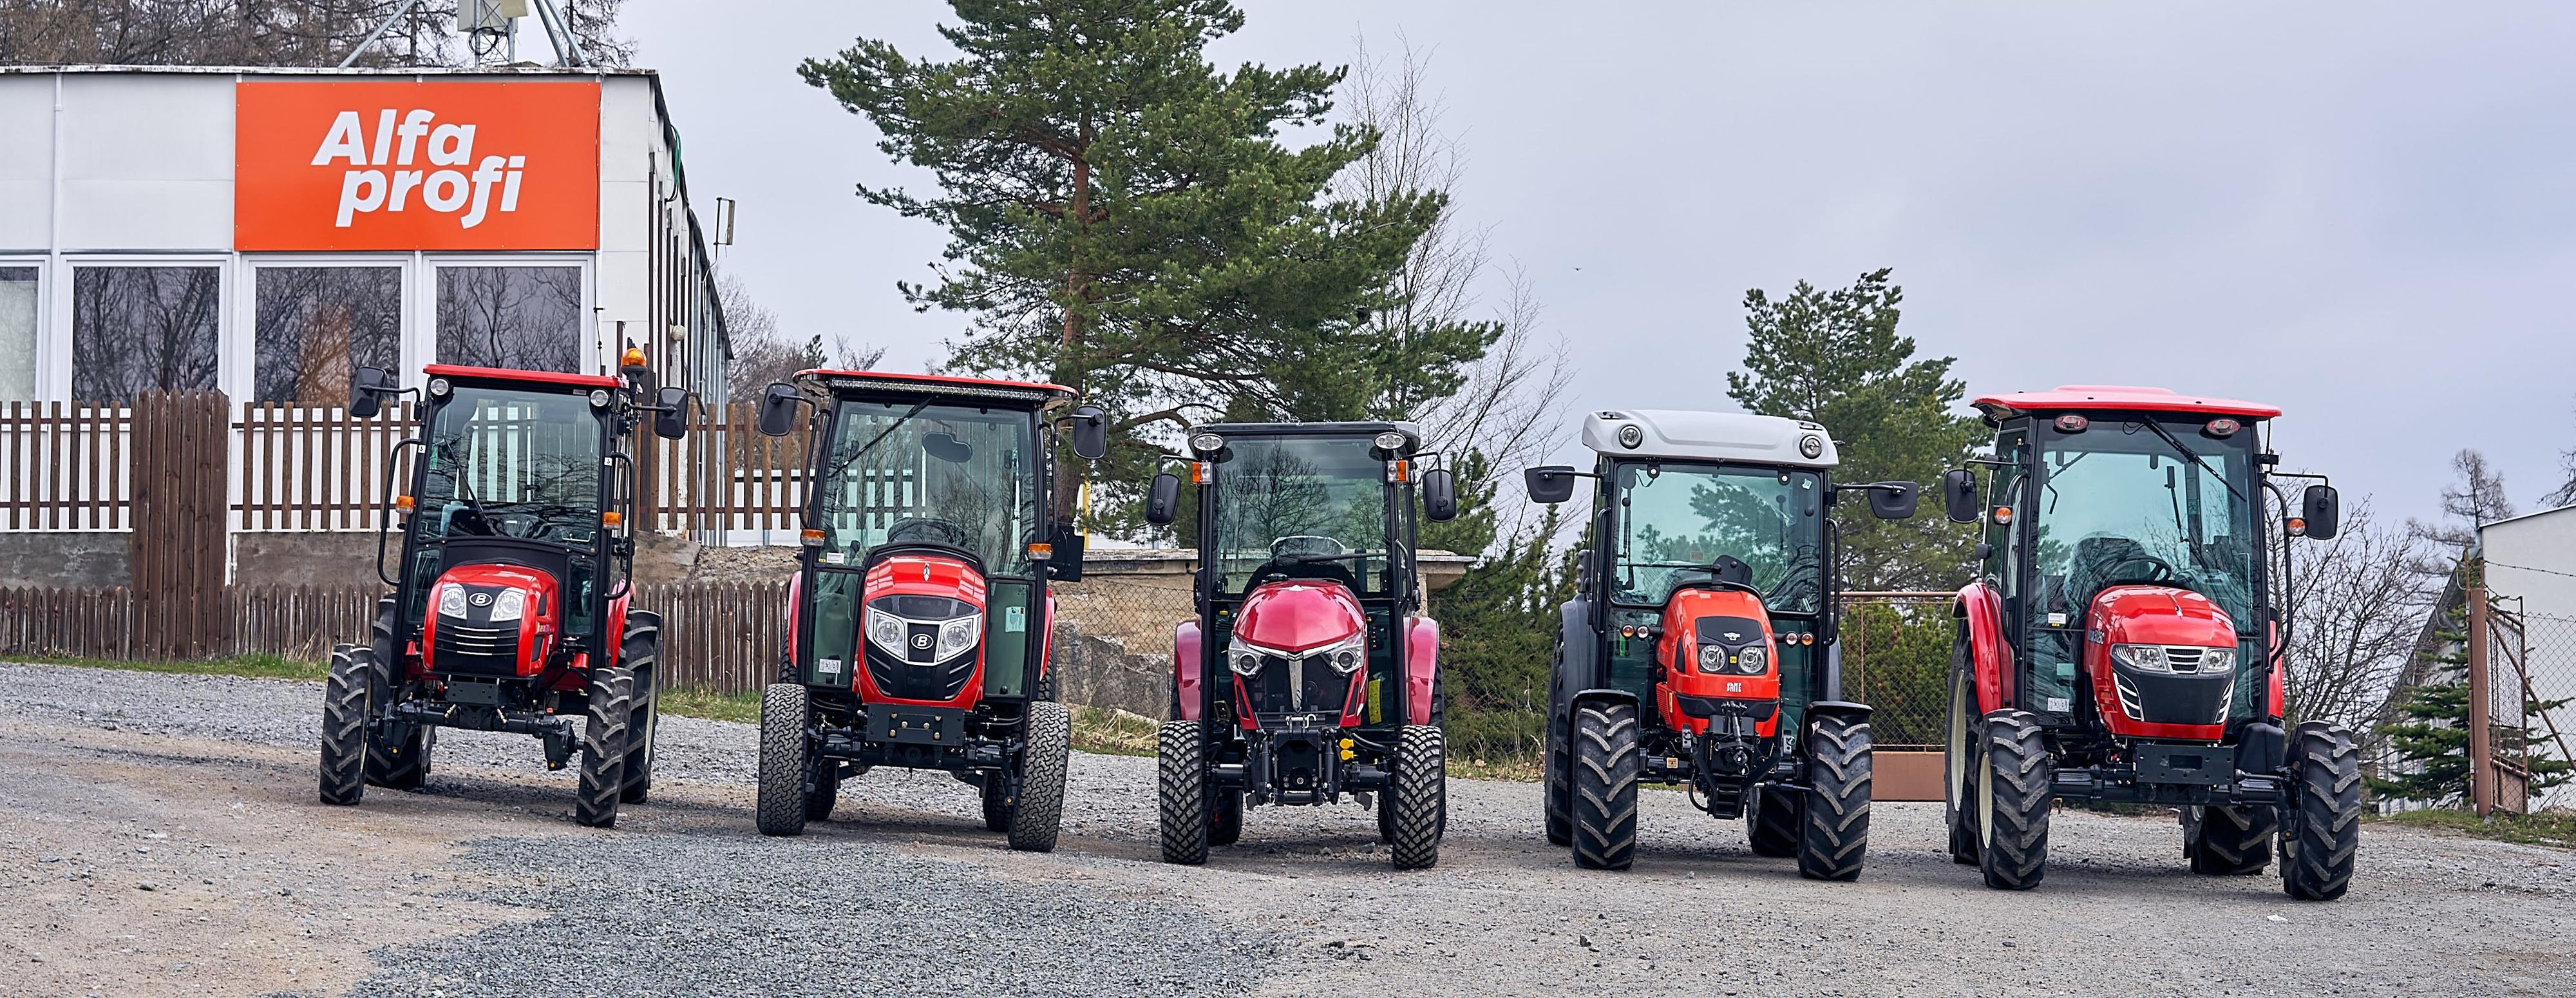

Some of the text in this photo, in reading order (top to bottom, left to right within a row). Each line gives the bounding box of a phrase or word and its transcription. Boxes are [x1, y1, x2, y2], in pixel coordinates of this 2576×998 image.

[310, 108, 477, 166] Alfa
[335, 155, 526, 229] profi
[475, 594, 487, 604] B
[917, 635, 928, 647] B
[1726, 682, 1742, 693] SAME
